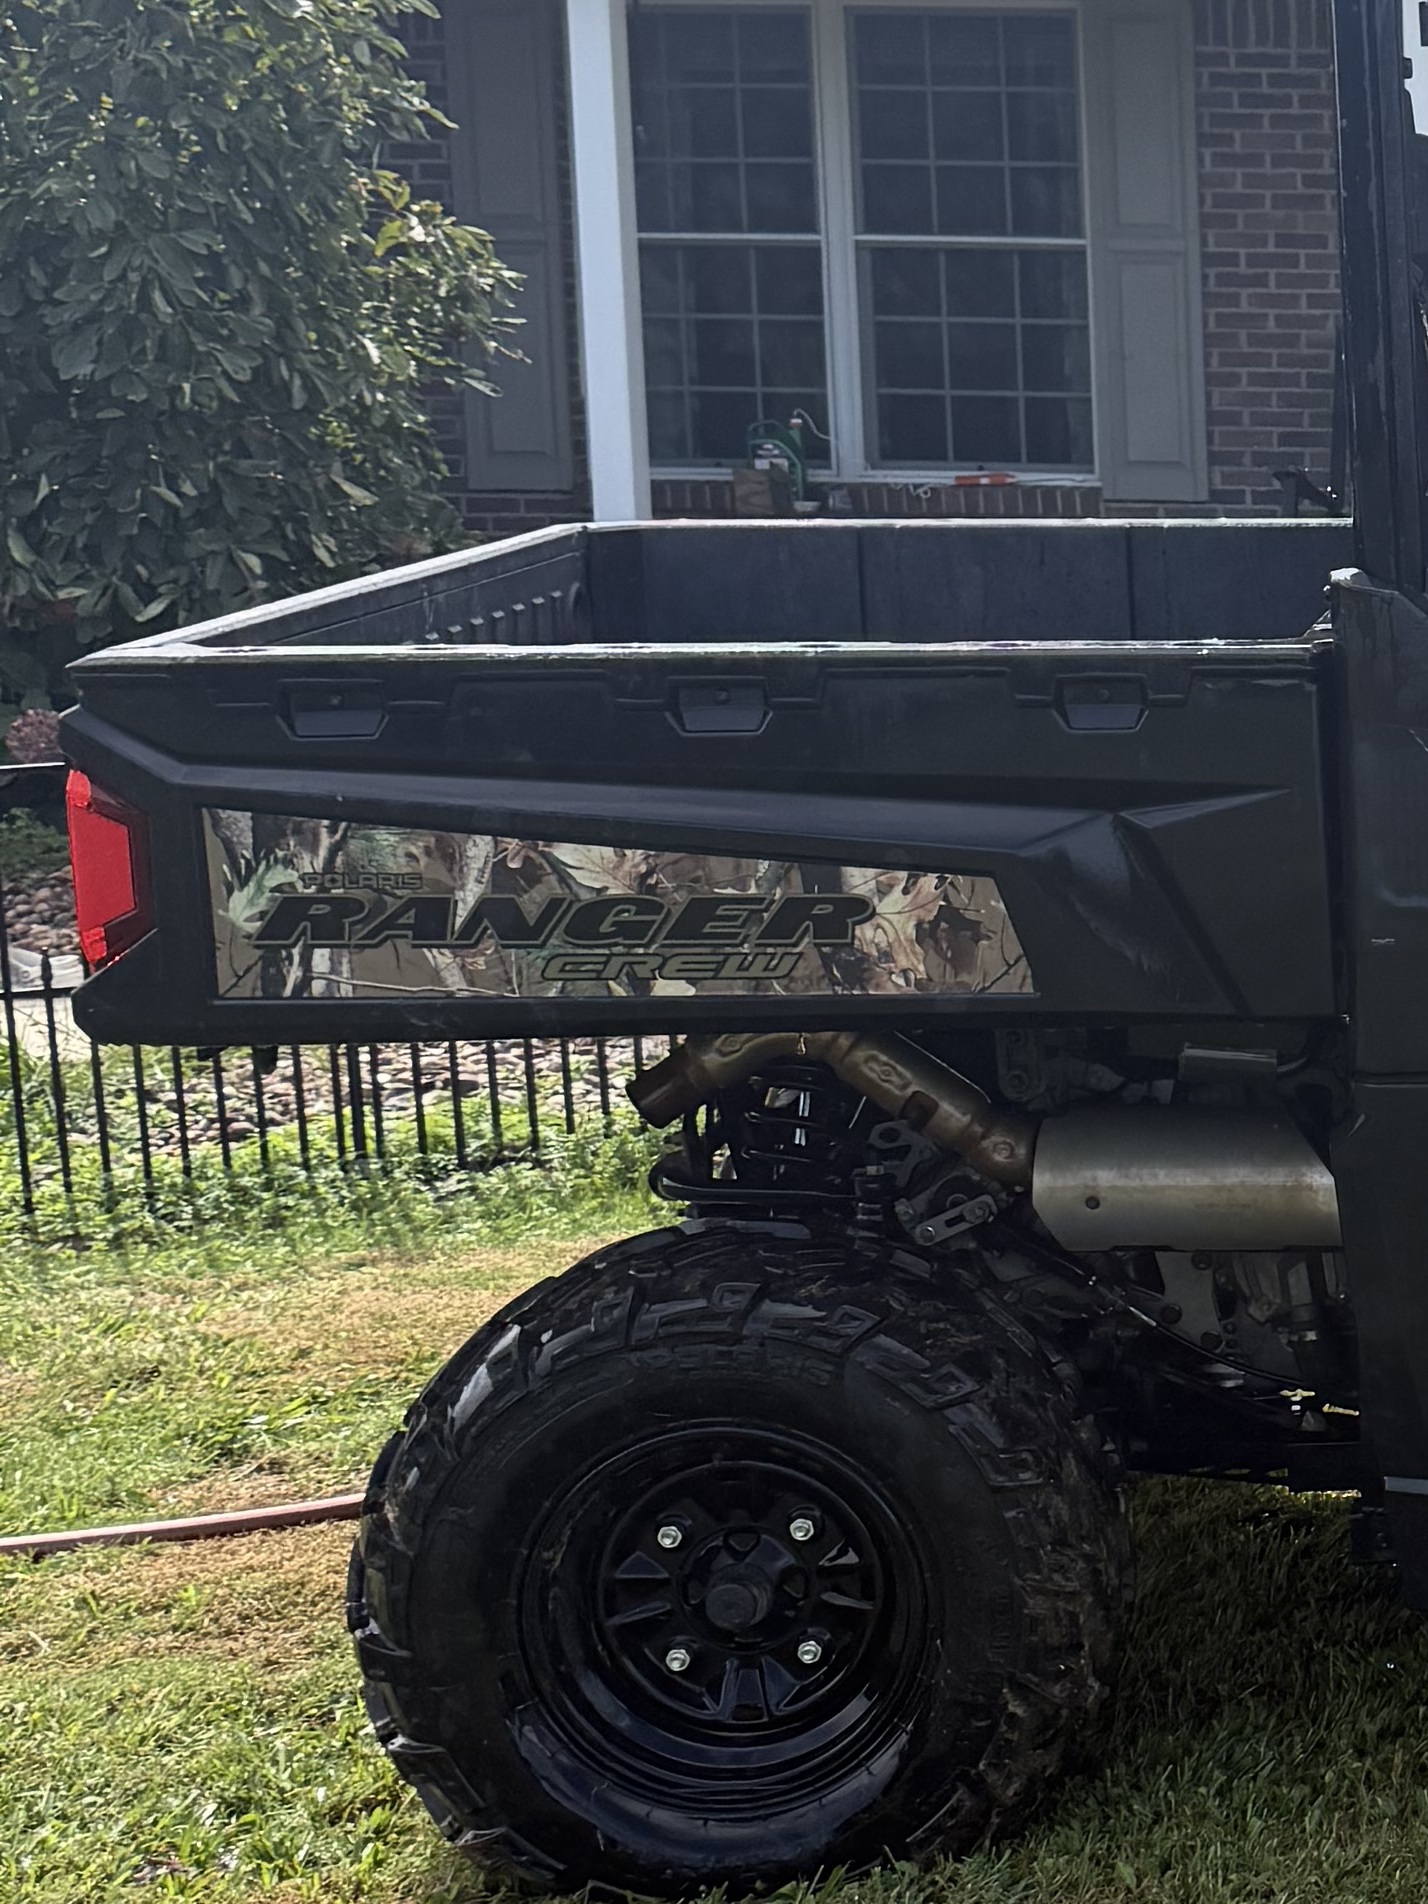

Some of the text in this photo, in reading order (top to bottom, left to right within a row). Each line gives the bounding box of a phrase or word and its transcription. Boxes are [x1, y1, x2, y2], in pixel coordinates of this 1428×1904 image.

[300, 872, 423, 890] POLARIS
[250, 894, 877, 949] RANGER
[541, 952, 805, 981] CREW
